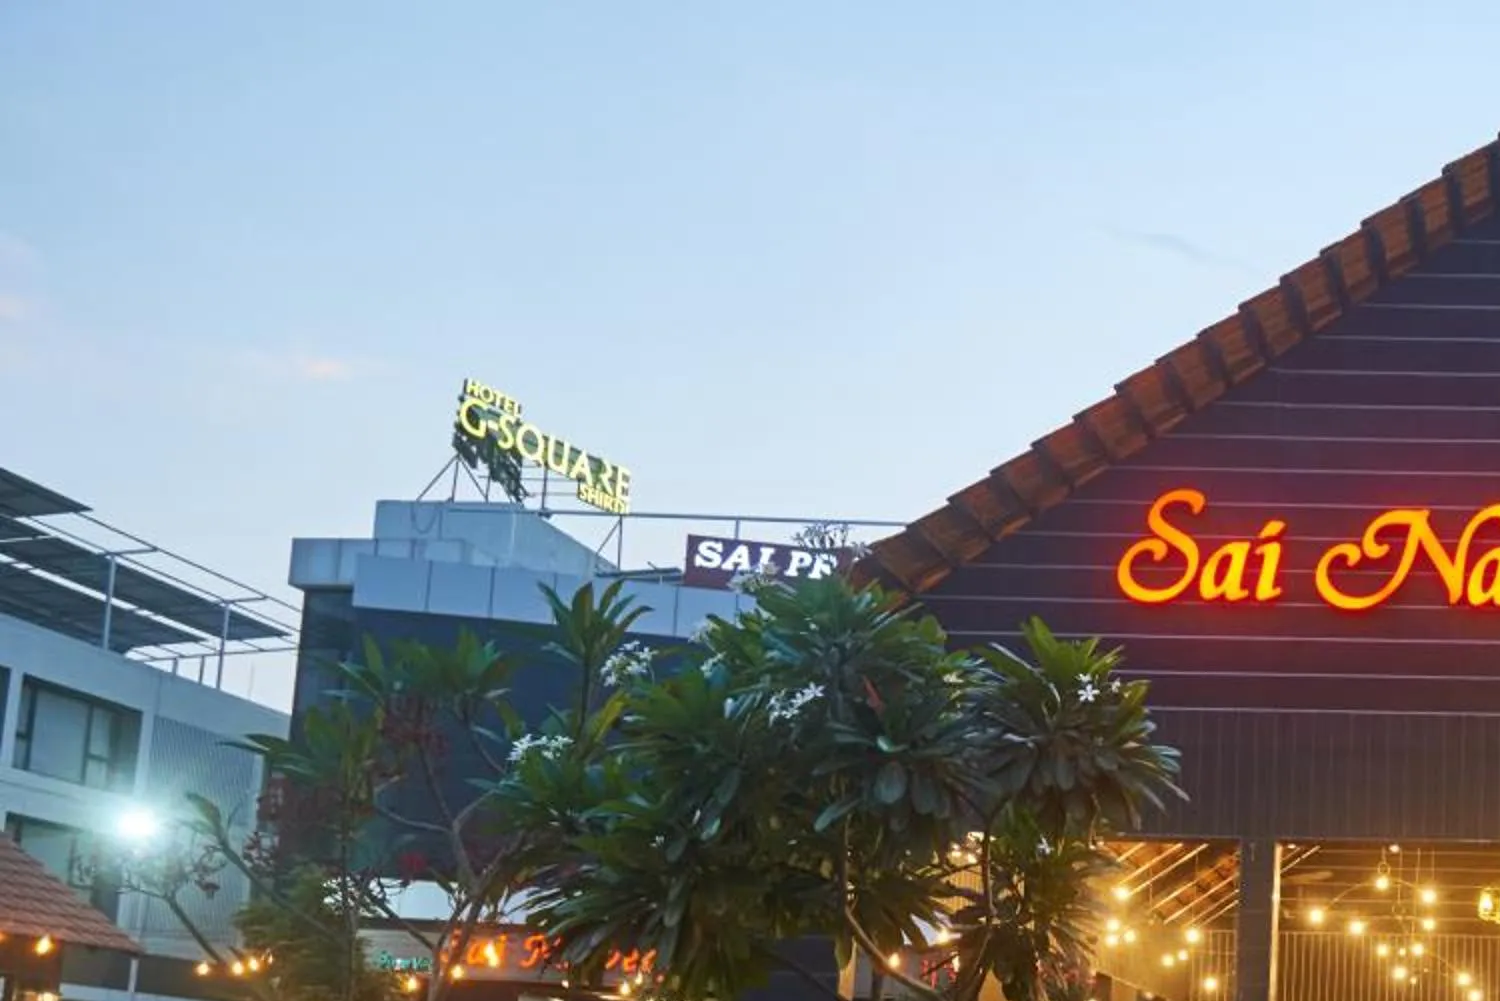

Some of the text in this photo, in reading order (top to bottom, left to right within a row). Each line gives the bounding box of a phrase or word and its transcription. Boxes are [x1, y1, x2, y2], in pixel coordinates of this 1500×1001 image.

[466, 378, 521, 418] HOTEL
[460, 398, 631, 500] G-SQUARE
[579, 483, 631, 514] SHIRDI
[1117, 488, 1287, 602] Sai
